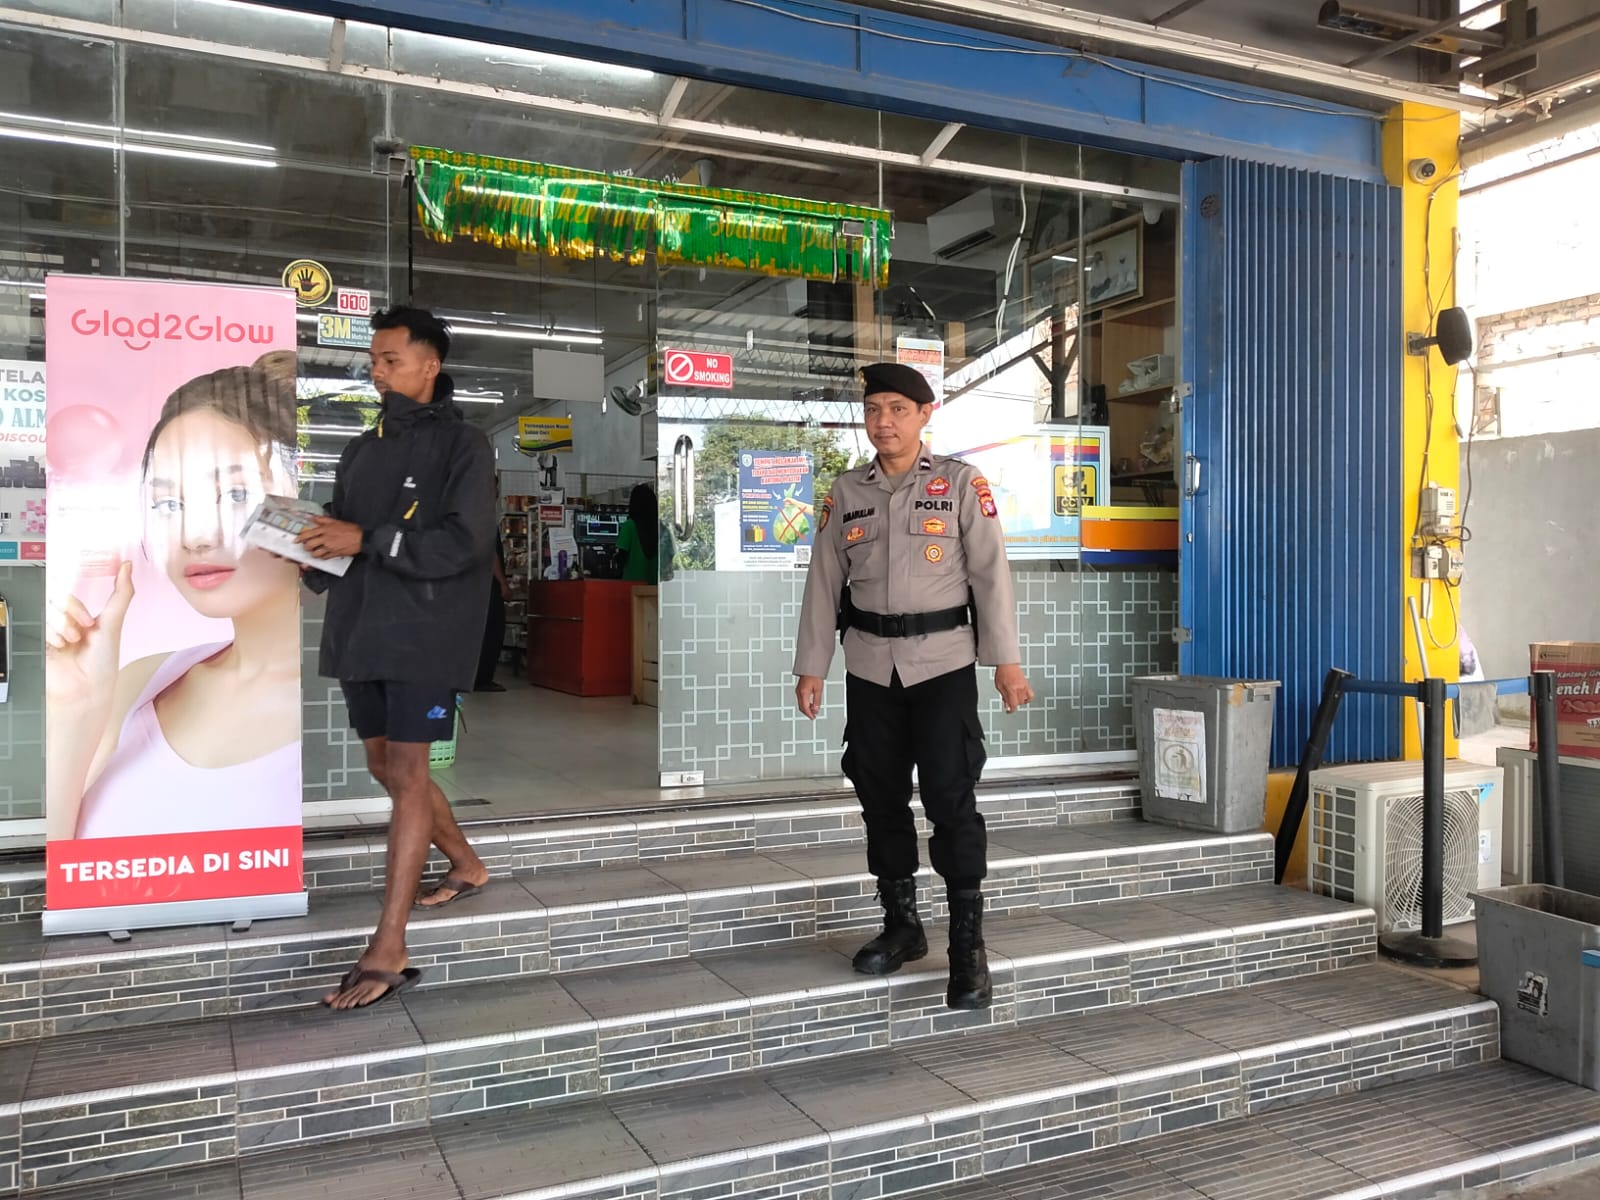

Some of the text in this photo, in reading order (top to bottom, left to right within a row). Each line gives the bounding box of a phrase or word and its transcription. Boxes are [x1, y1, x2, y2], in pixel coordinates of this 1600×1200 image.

[340, 294, 368, 311] 110
[71, 309, 274, 344] Glad2Glow
[320, 316, 351, 339] 3M
[706, 358, 718, 369] NO
[694, 371, 730, 383] SMOKING
[4, 388, 46, 403] KOS
[915, 501, 953, 512] POLRI
[60, 848, 290, 883] TERSEDIA DI SINI
